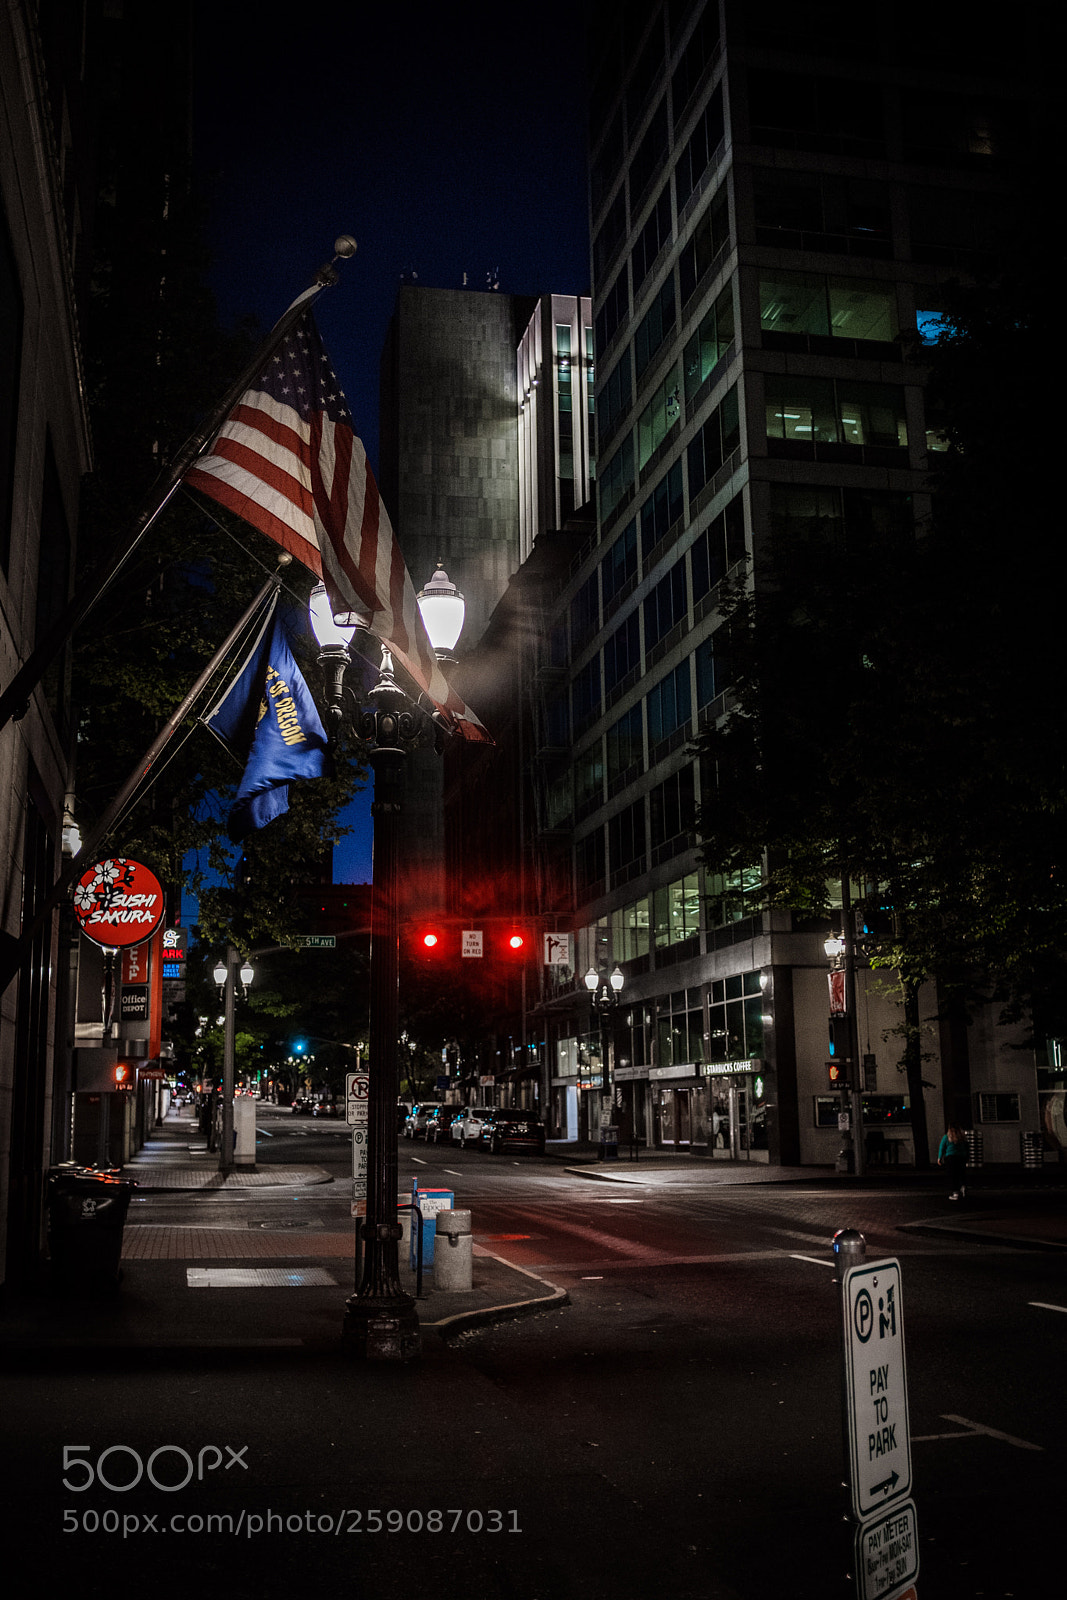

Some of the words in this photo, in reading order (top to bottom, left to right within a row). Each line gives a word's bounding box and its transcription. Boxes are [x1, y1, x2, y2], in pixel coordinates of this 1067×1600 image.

[269, 680, 290, 698] OF
[274, 697, 308, 746] OREGON
[109, 894, 157, 908] SUSHI
[88, 910, 156, 925] SAKURA
[162, 949, 183, 958] ARK
[122, 995, 146, 1004] Office
[122, 1004, 145, 1012] DEPOT
[706, 1062, 734, 1075] STARBUCKS
[733, 1060, 752, 1071] COFFEE
[869, 1363, 890, 1397] PAY
[873, 1396, 889, 1426] TO
[868, 1423, 898, 1462] PARK
[868, 1530, 882, 1554] PAY
[883, 1515, 909, 1544] METER
[895, 1556, 908, 1578] SUN
